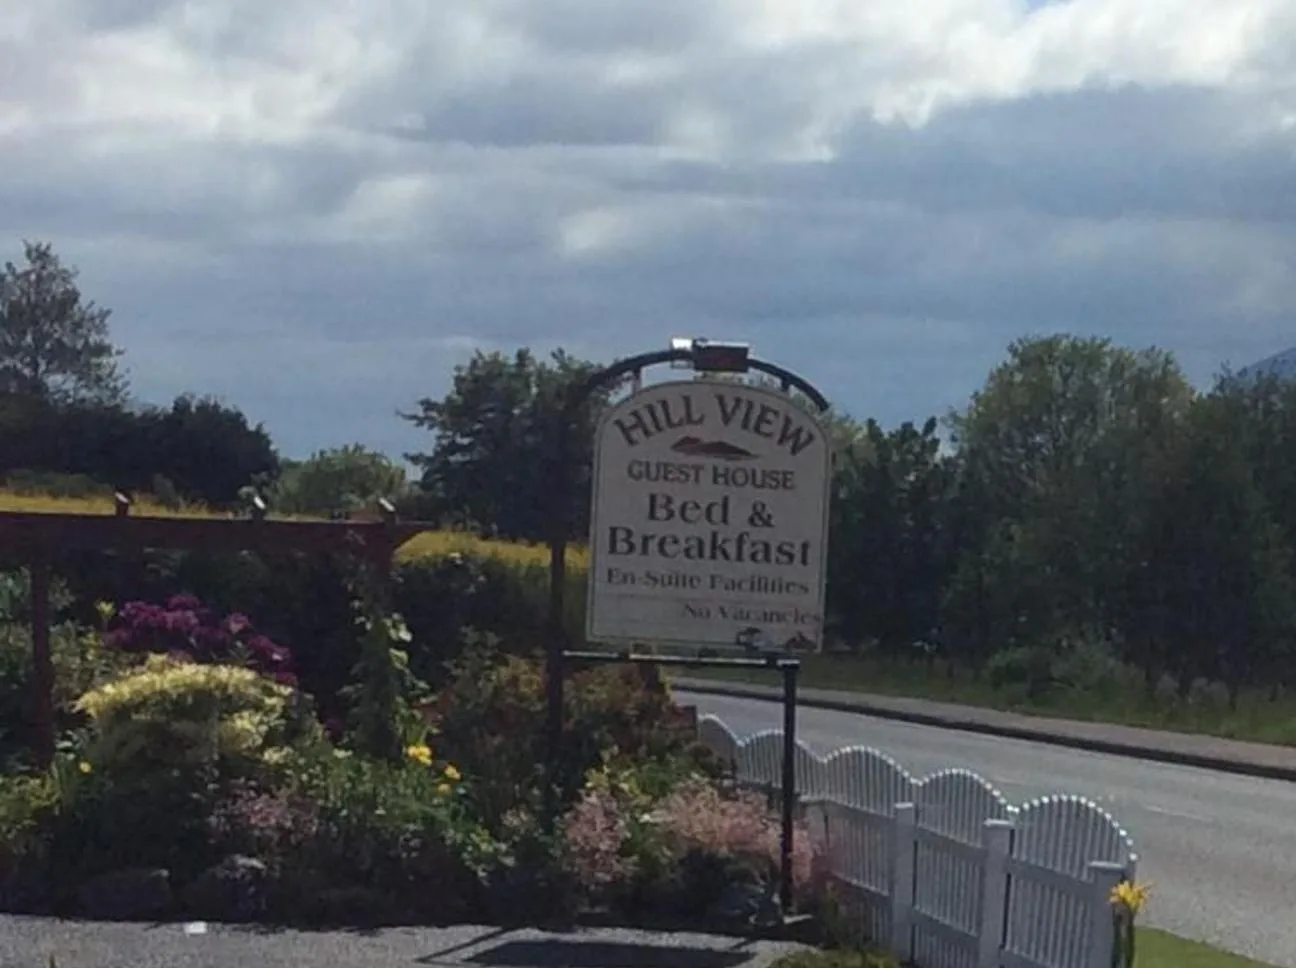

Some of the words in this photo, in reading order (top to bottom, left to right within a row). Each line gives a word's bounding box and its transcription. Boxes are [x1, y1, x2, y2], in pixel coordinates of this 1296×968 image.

[614, 395, 705, 446] HILL
[715, 393, 815, 456] VIEW
[627, 460, 705, 483] GUEST
[712, 465, 796, 489] HOUSE
[648, 493, 730, 526] Bed
[748, 501, 776, 528] &
[608, 526, 812, 567] Breakfast
[709, 573, 810, 595] Facilities
[684, 604, 711, 619] No
